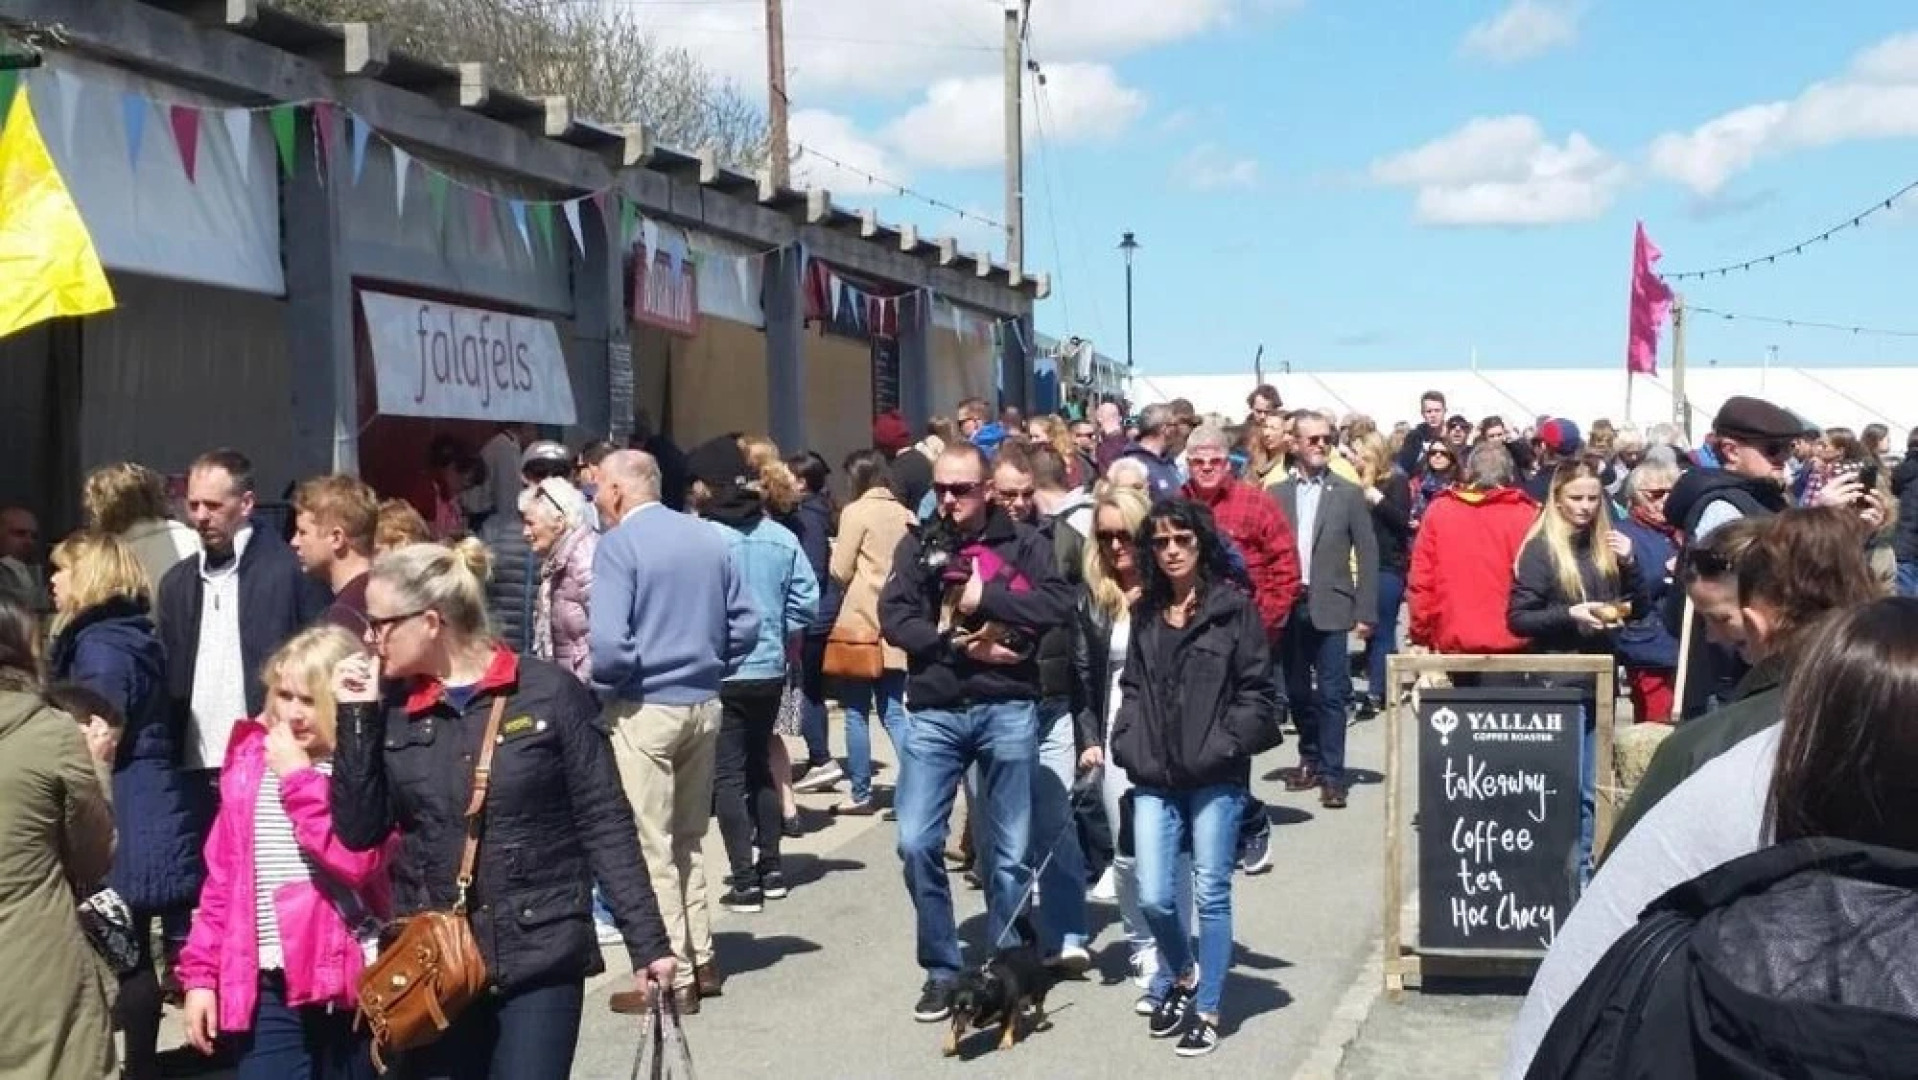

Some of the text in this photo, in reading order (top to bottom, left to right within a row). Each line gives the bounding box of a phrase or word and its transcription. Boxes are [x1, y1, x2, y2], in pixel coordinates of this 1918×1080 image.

[415, 304, 533, 408] falafels
[1466, 711, 1563, 731] YALLAH
[1473, 732, 1509, 742] COFFEE
[1451, 816, 1535, 864] Coffee
[1457, 858, 1503, 895] tea
